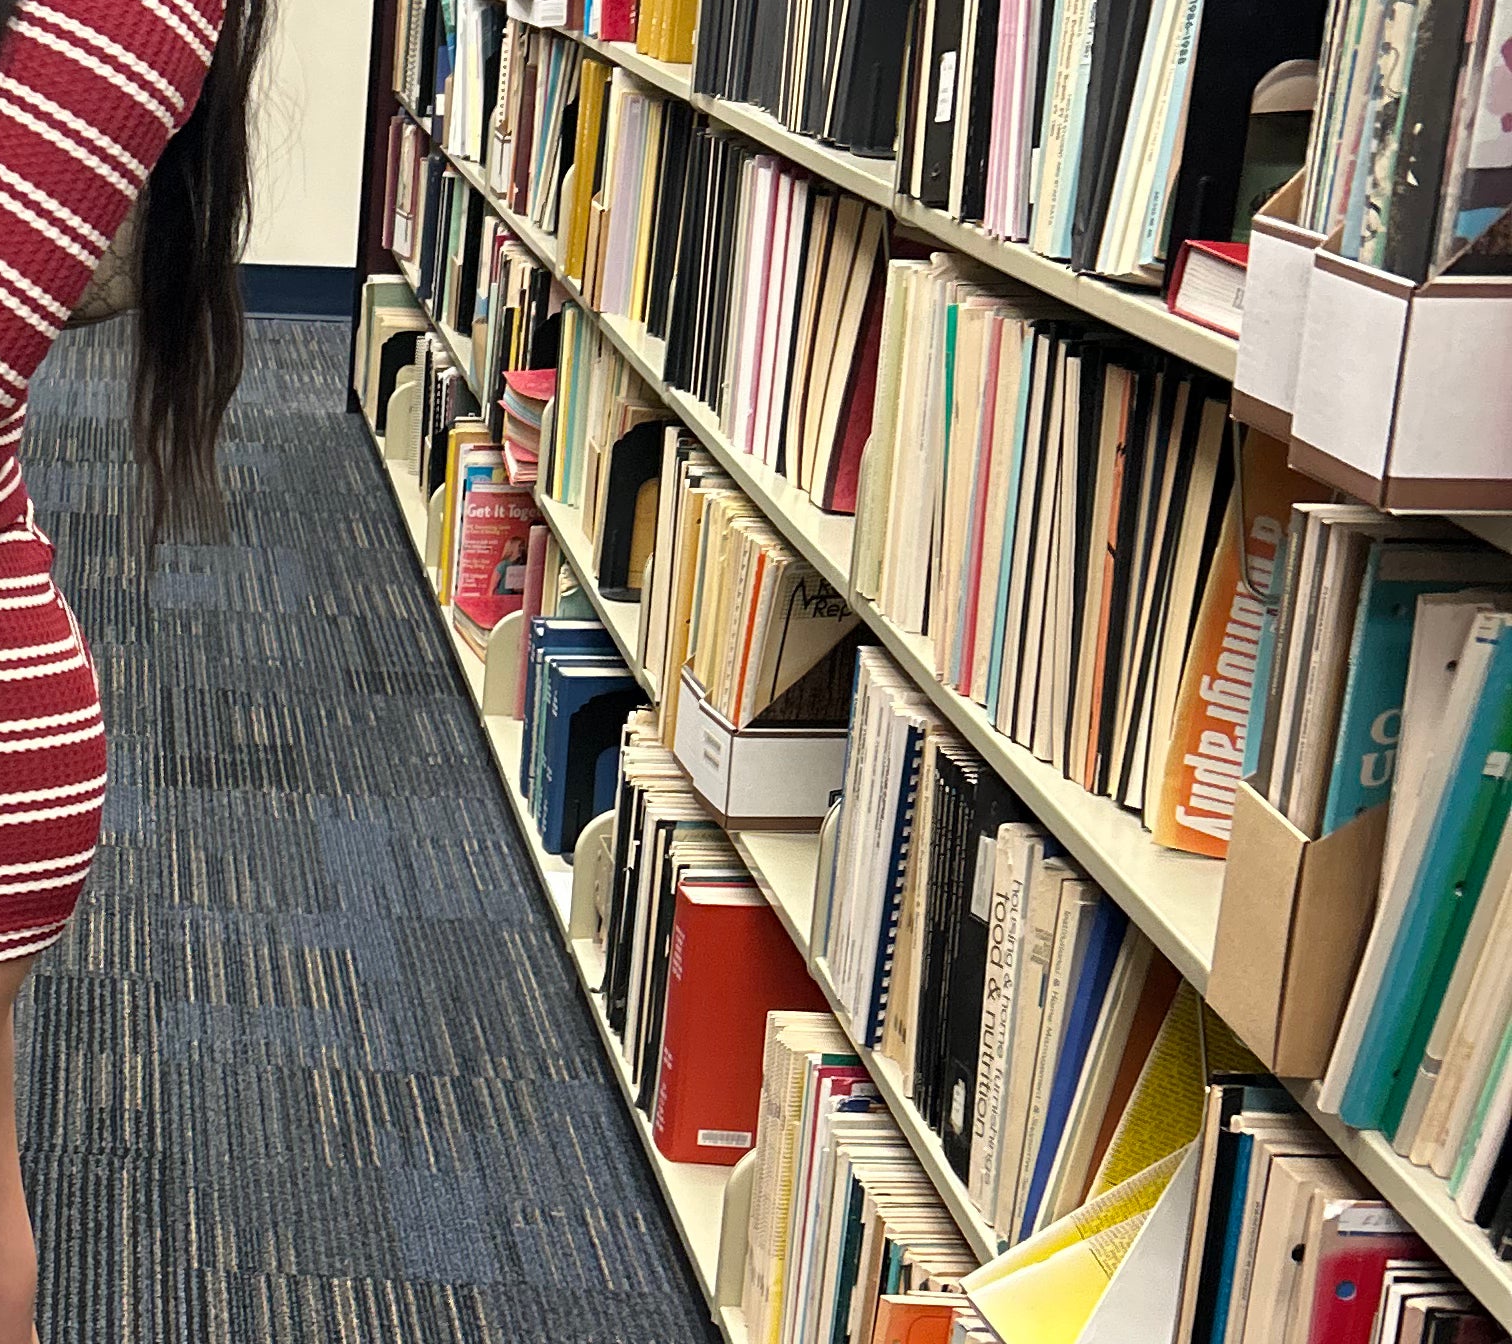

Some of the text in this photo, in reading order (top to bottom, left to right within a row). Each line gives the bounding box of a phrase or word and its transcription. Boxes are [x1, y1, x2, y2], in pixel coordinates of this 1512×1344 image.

[468, 504, 542, 521] Get It Toge
[972, 891, 1010, 1138] food & nutrition
[979, 879, 1024, 1186] housing & home furnishings
